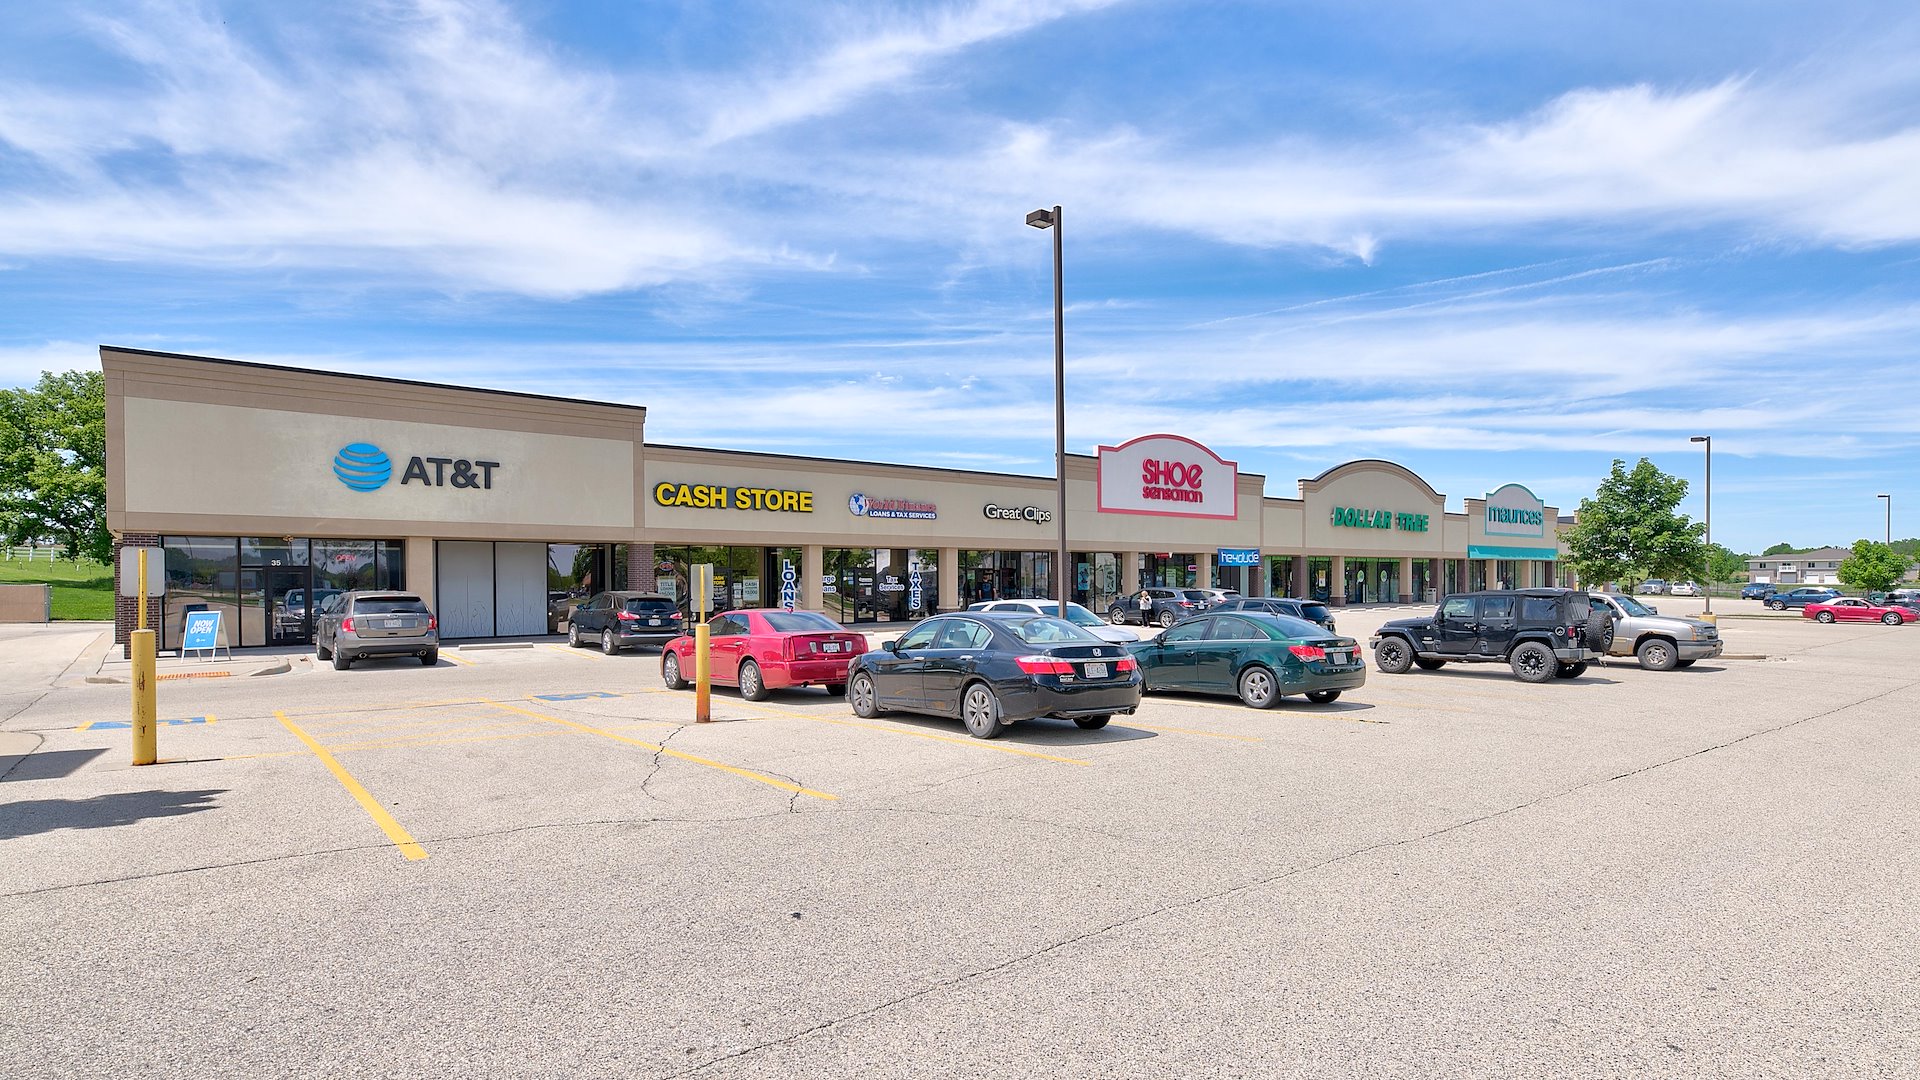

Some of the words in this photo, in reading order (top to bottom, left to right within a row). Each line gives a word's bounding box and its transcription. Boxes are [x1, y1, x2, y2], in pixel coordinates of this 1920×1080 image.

[401, 456, 500, 490] AT&T
[655, 482, 728, 508] CASH
[735, 487, 813, 513] STORE
[984, 504, 1021, 520] Great
[1023, 507, 1051, 524] Clips
[1332, 507, 1392, 529] DOLLAR
[1397, 512, 1429, 531] TREE
[1488, 506, 1542, 526] maurices
[782, 559, 796, 609] LOANS
[822, 575, 836, 584] rge
[823, 585, 837, 593] ans
[910, 562, 922, 609] TAXES
[190, 626, 213, 634] OPEN
[194, 619, 215, 628] NOW
